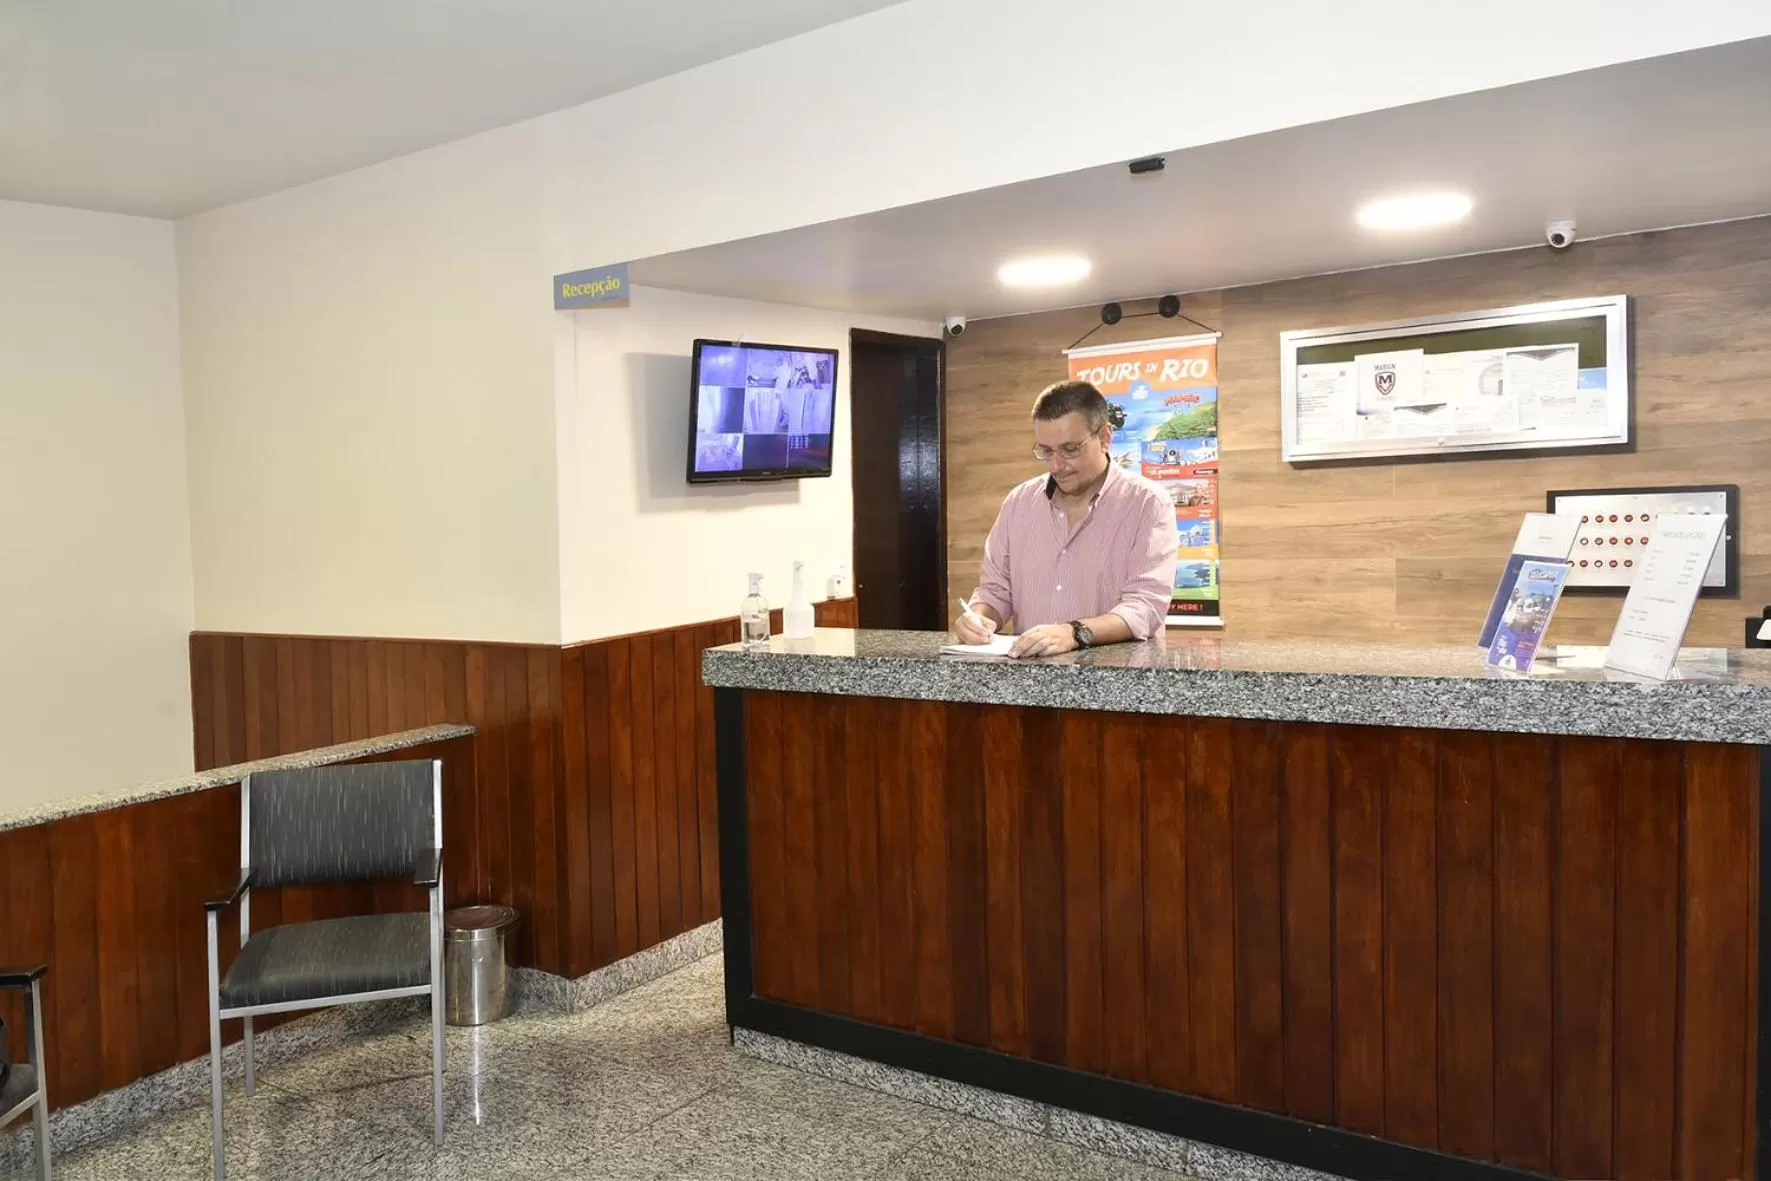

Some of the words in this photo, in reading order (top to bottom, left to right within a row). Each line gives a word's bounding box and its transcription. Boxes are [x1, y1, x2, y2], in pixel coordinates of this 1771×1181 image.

[562, 276, 620, 298] Recepção
[1076, 361, 1141, 386] TOURS
[1159, 358, 1208, 382] RIO
[1378, 374, 1393, 385] M
